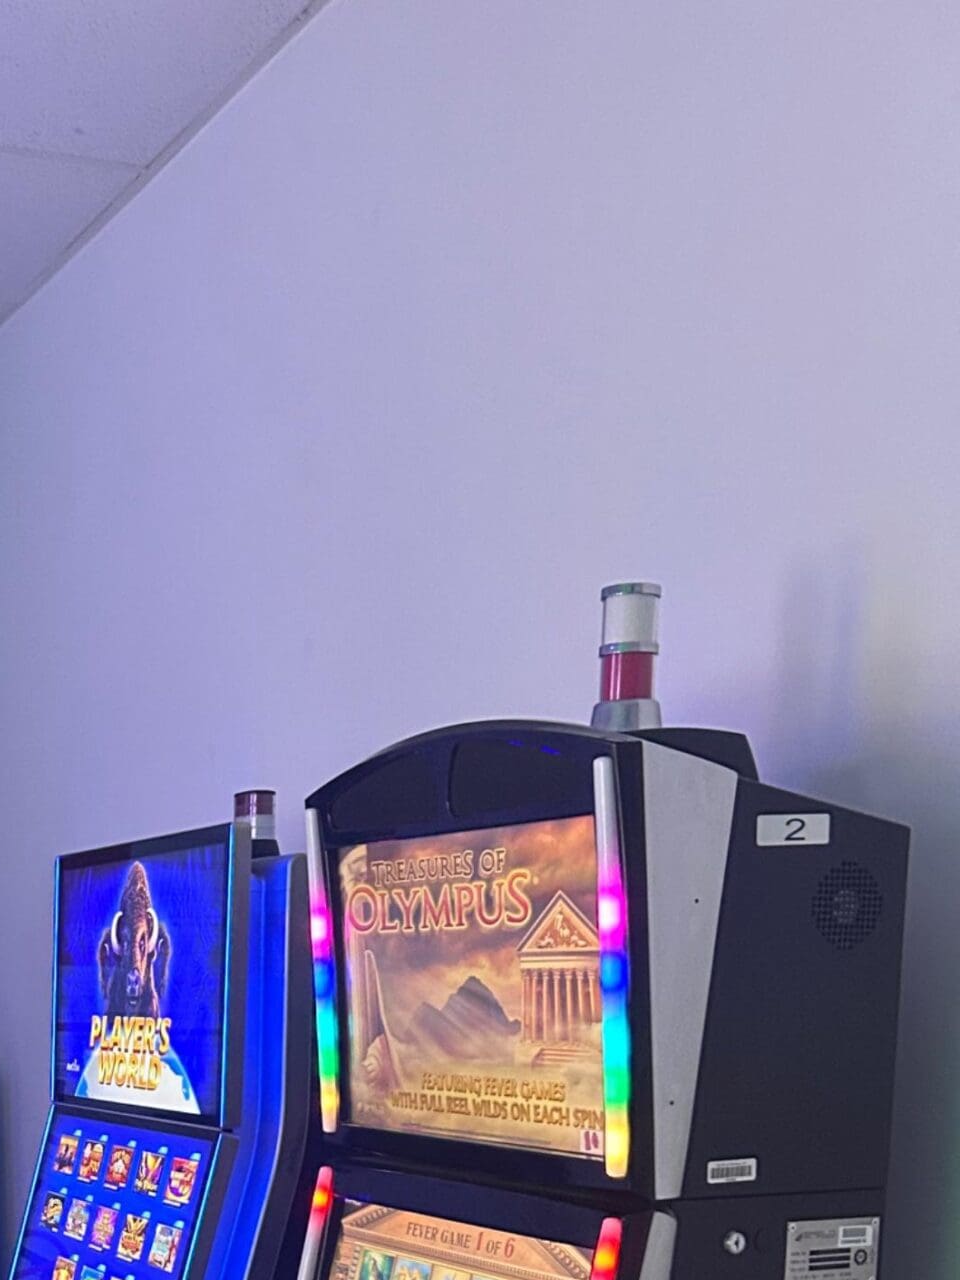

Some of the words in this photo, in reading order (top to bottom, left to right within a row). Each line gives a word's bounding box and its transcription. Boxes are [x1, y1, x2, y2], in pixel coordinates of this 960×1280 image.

[784, 818, 806, 841] 2
[372, 850, 473, 886] TREASURES
[481, 848, 507, 873] OF
[348, 872, 532, 934] OLYMPUS
[90, 1014, 172, 1056] PLAYER'S
[98, 1051, 162, 1091] WORLD
[483, 1077, 519, 1099] FEVER
[520, 1079, 567, 1102] GAMES
[390, 1091, 419, 1109] WITH
[420, 1093, 445, 1113] FULL
[446, 1095, 471, 1116] REEL
[472, 1098, 509, 1120] WILDS
[510, 1101, 531, 1123] ON
[533, 1104, 571, 1126] EACH
[406, 1221, 439, 1241] FEVER
[440, 1229, 472, 1249] GAME
[476, 1231, 484, 1251] 1
[486, 1239, 502, 1256] OF
[504, 1237, 515, 1258] 6
